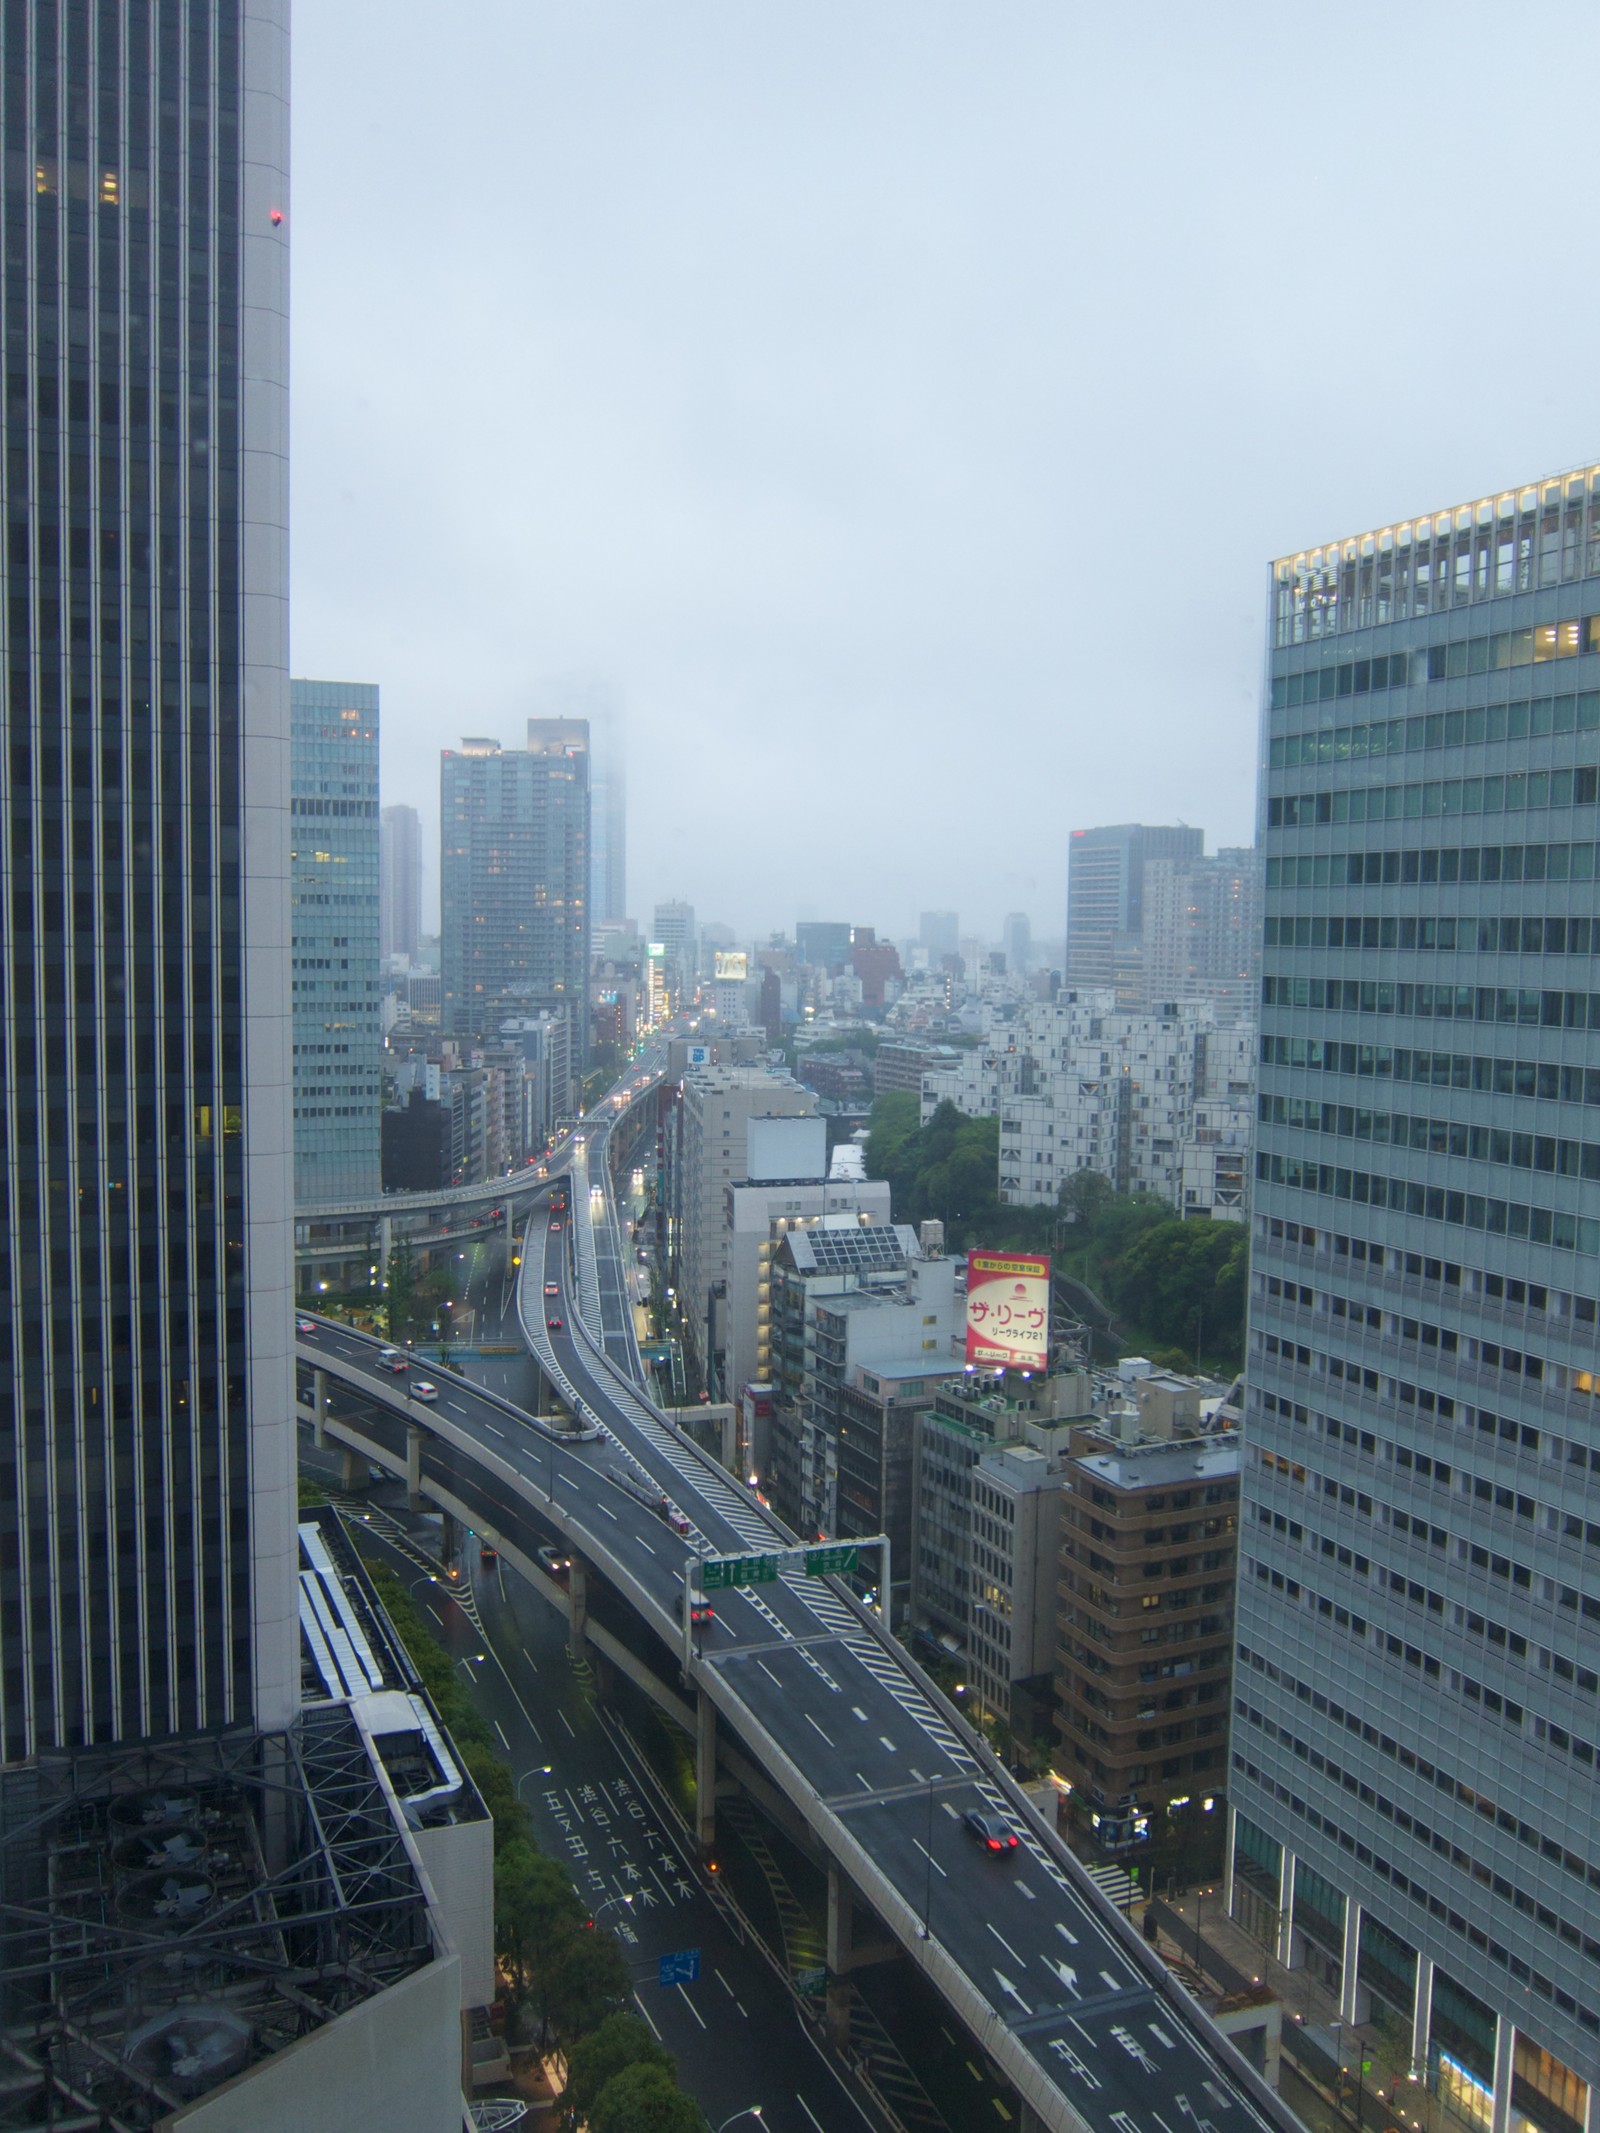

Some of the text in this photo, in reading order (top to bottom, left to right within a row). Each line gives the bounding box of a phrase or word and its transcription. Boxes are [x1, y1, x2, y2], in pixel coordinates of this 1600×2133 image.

[969, 1301, 1046, 1329] ザ・リーヴ
[577, 1784, 660, 1908] 渋谷・六本木
[611, 1778, 696, 1900] 渋谷・六本木
